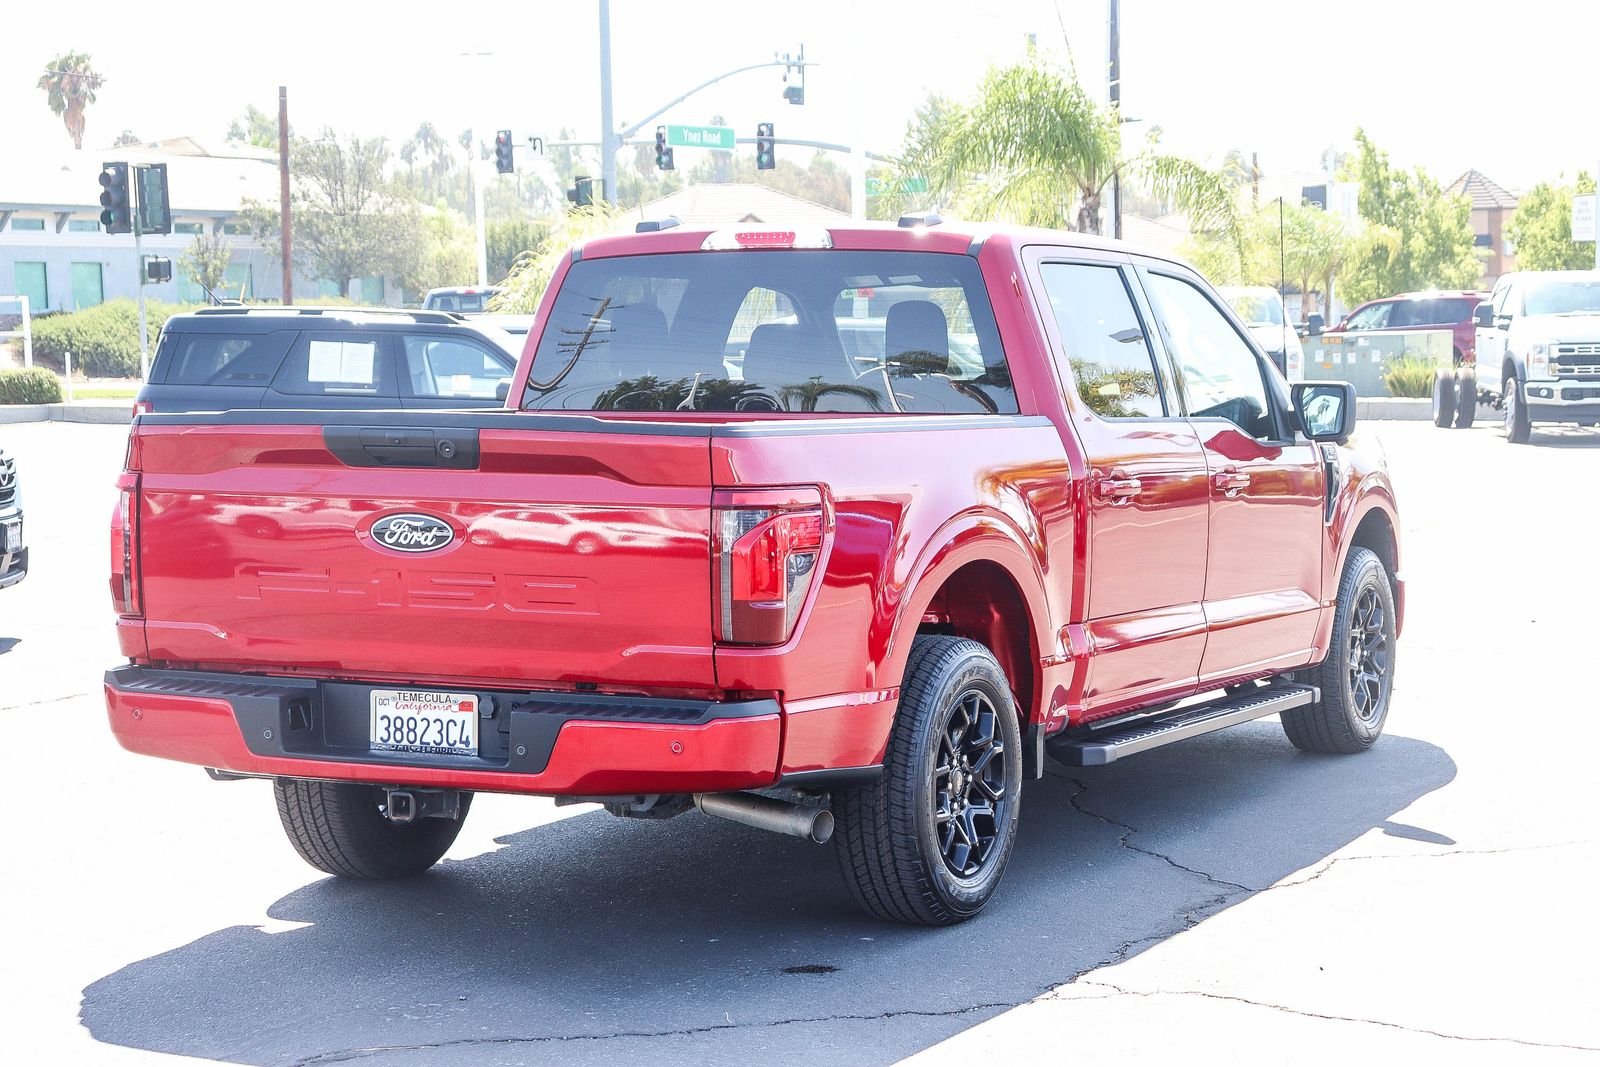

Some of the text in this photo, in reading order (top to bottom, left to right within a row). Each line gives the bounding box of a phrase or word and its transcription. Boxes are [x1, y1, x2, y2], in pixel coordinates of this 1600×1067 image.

[682, 128, 721, 145] Ynez Road
[384, 518, 438, 546] Ford
[234, 562, 600, 616] F-150
[395, 701, 456, 715] California
[397, 692, 452, 704] TEMECULA
[379, 715, 471, 748] 38823C4
